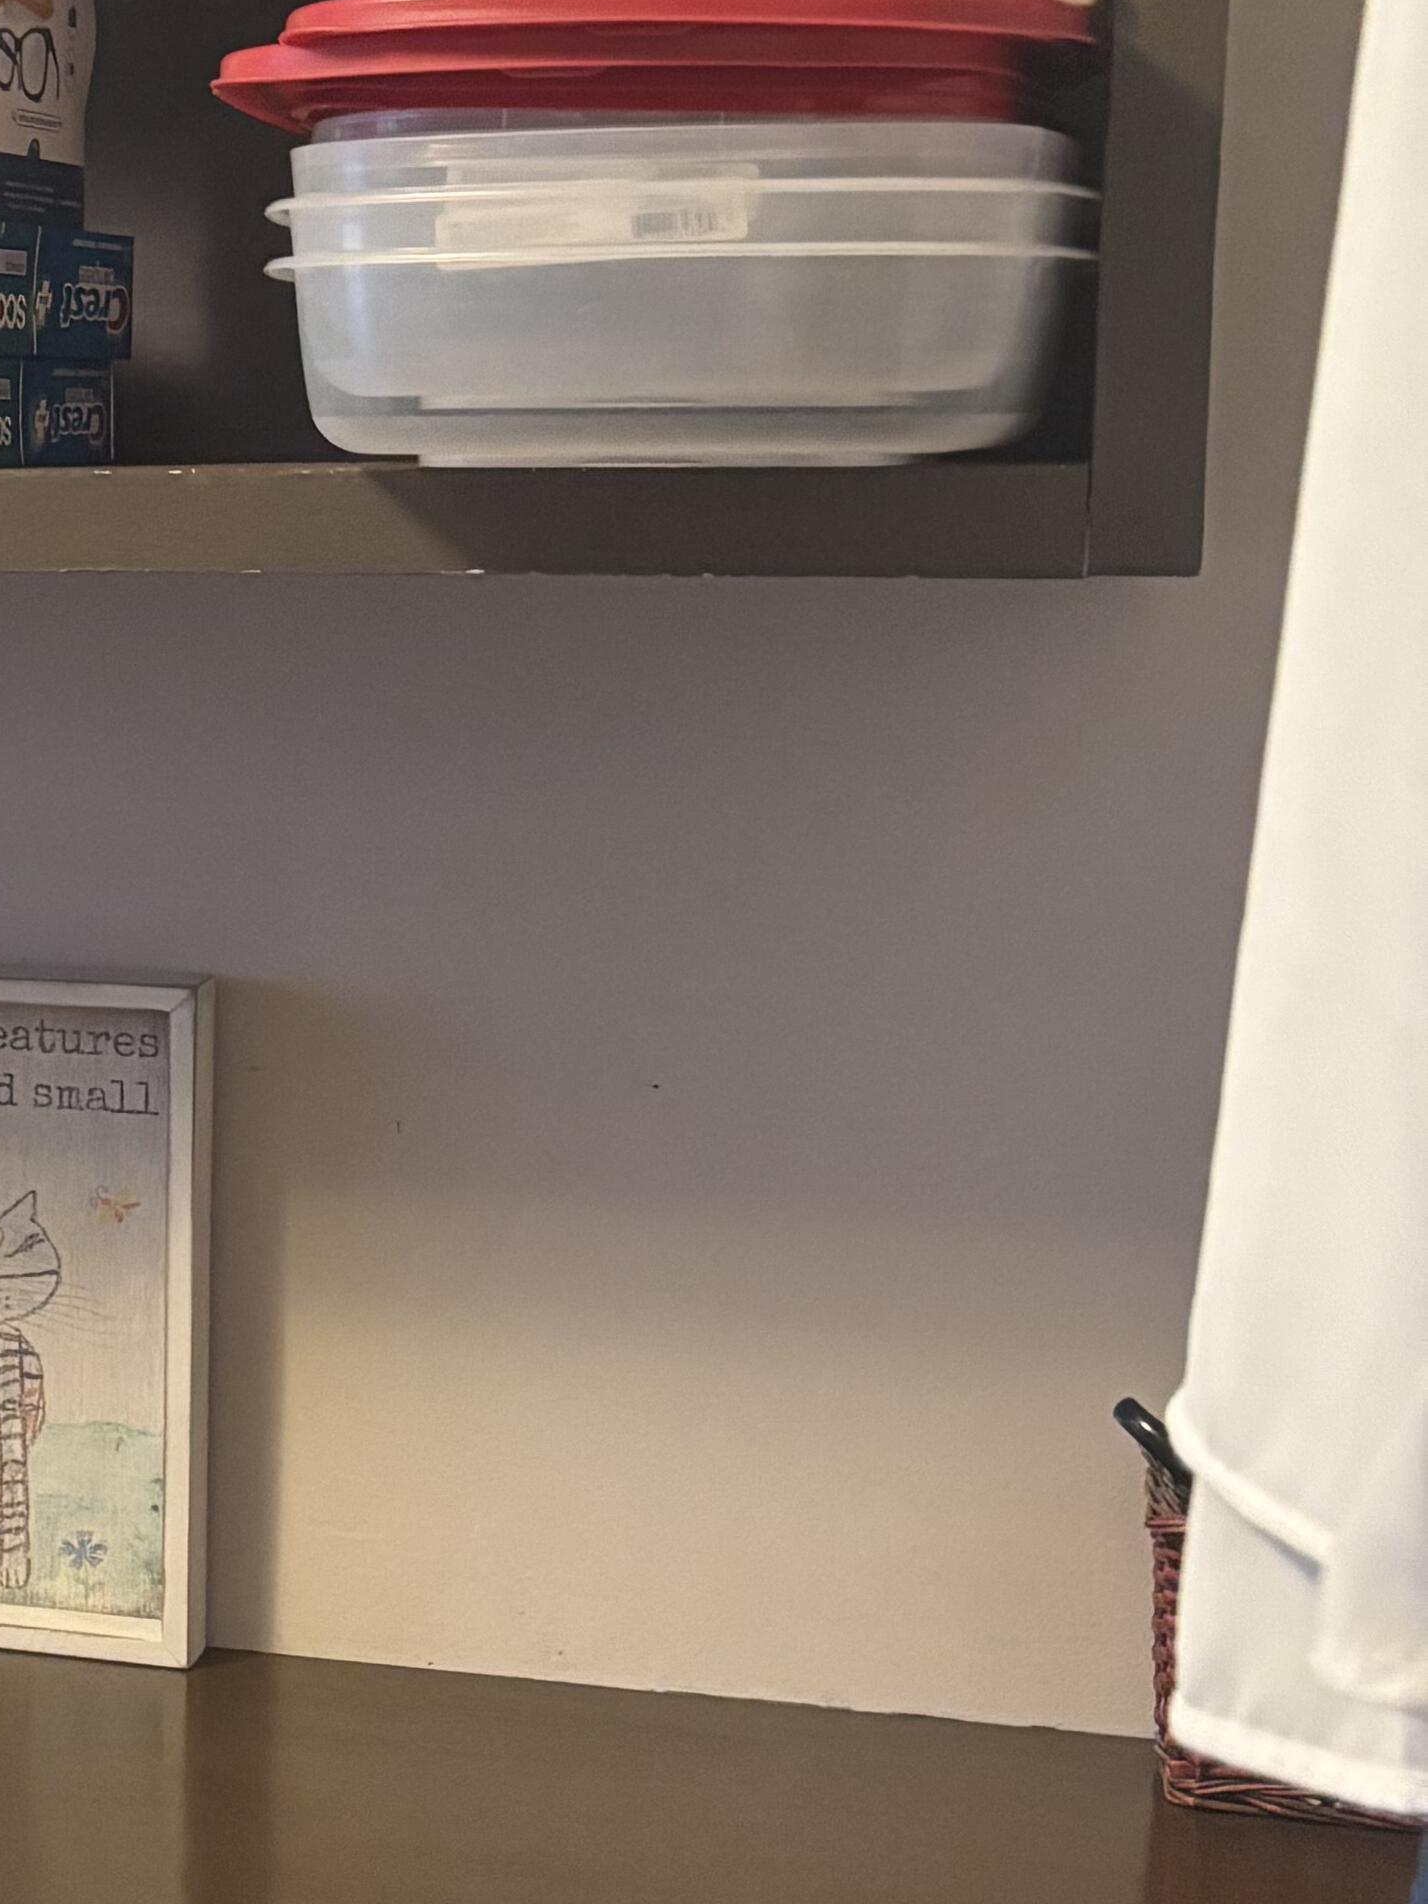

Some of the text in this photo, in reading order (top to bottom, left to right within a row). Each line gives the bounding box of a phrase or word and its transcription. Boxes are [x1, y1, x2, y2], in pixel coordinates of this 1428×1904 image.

[60, 283, 128, 335] Crest
[51, 402, 107, 445] Crest
[32, 1079, 160, 1117] small
